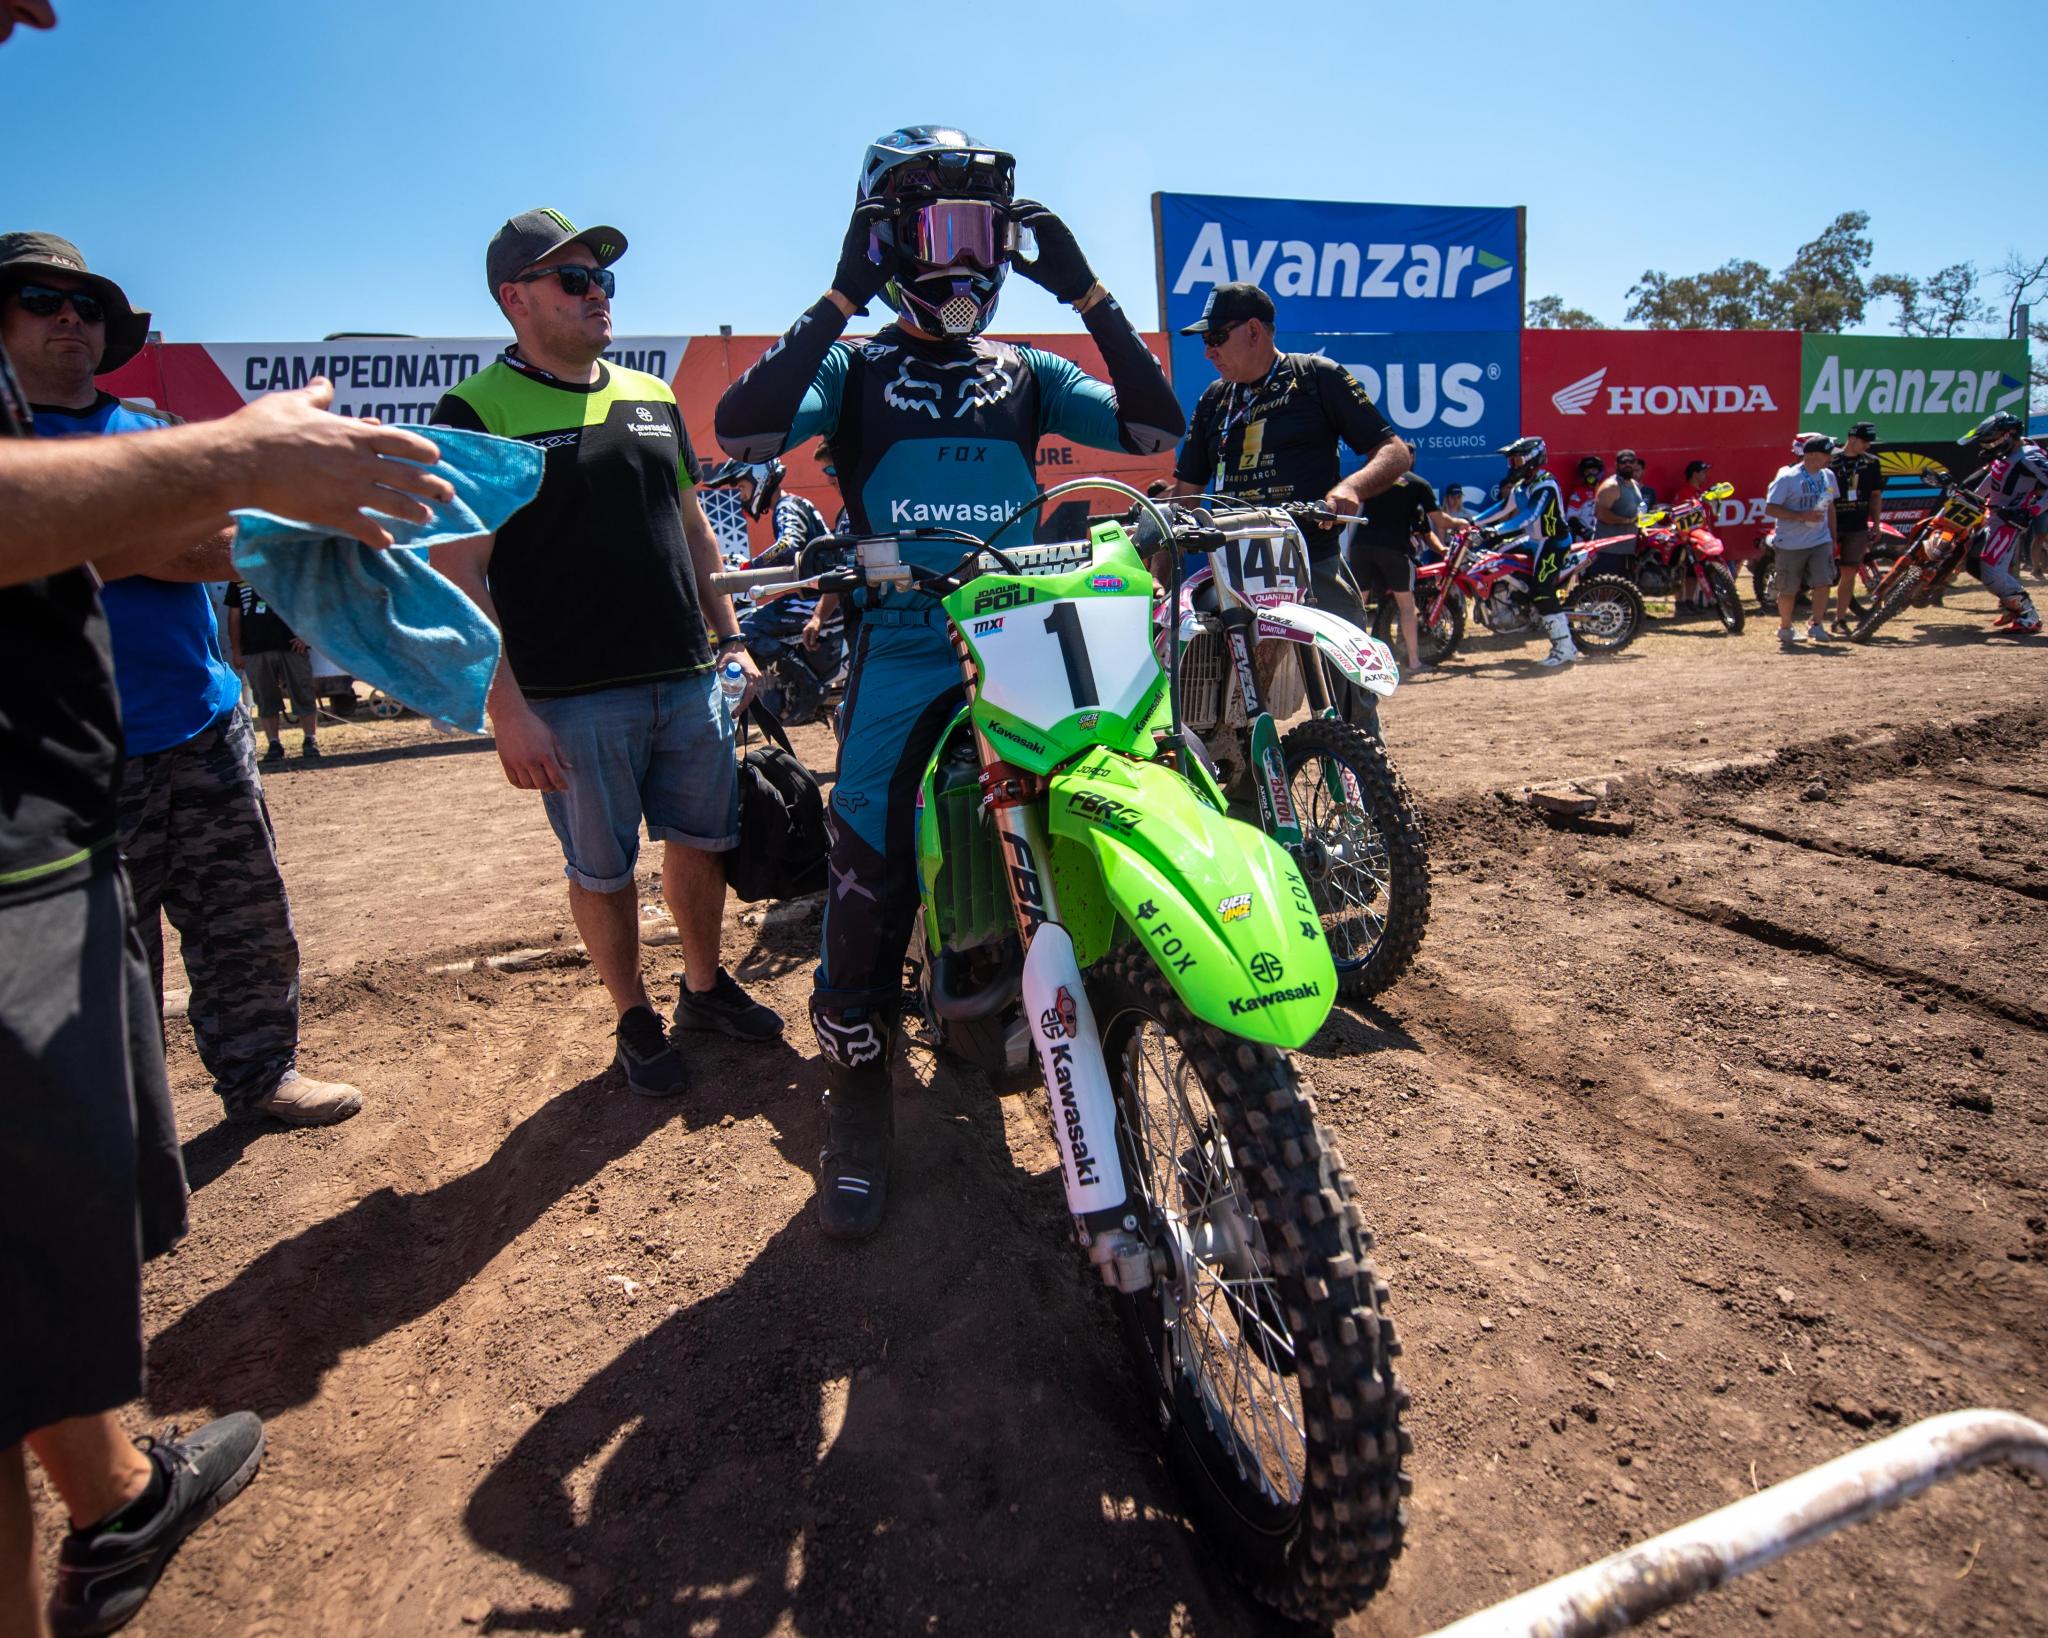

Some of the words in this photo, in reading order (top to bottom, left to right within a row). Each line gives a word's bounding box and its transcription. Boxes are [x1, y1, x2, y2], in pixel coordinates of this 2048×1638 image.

[1173, 222, 1475, 298] Avanzar
[246, 353, 479, 390] CAMPEONATO
[1804, 355, 2001, 414] Avanzar
[1606, 384, 1778, 415] HONDA
[627, 423, 672, 434] Kawasaki
[1428, 435, 1487, 449] SEGUROS
[938, 446, 988, 462] FOX
[891, 499, 1021, 523] Kawasaki
[1945, 502, 1980, 526] 15
[1226, 538, 1303, 590] 144
[974, 587, 1035, 615] POLI
[975, 583, 1020, 599] JOAQUIN
[1044, 602, 1100, 709] 1
[1134, 689, 1165, 735] Kawasaki
[988, 720, 1046, 756] Kawasaki
[1284, 871, 1313, 915] FOX
[1150, 922, 1197, 975] FOX
[1228, 982, 1320, 1016] Kawasaki
[1050, 1044, 1100, 1187] Kawasaki
